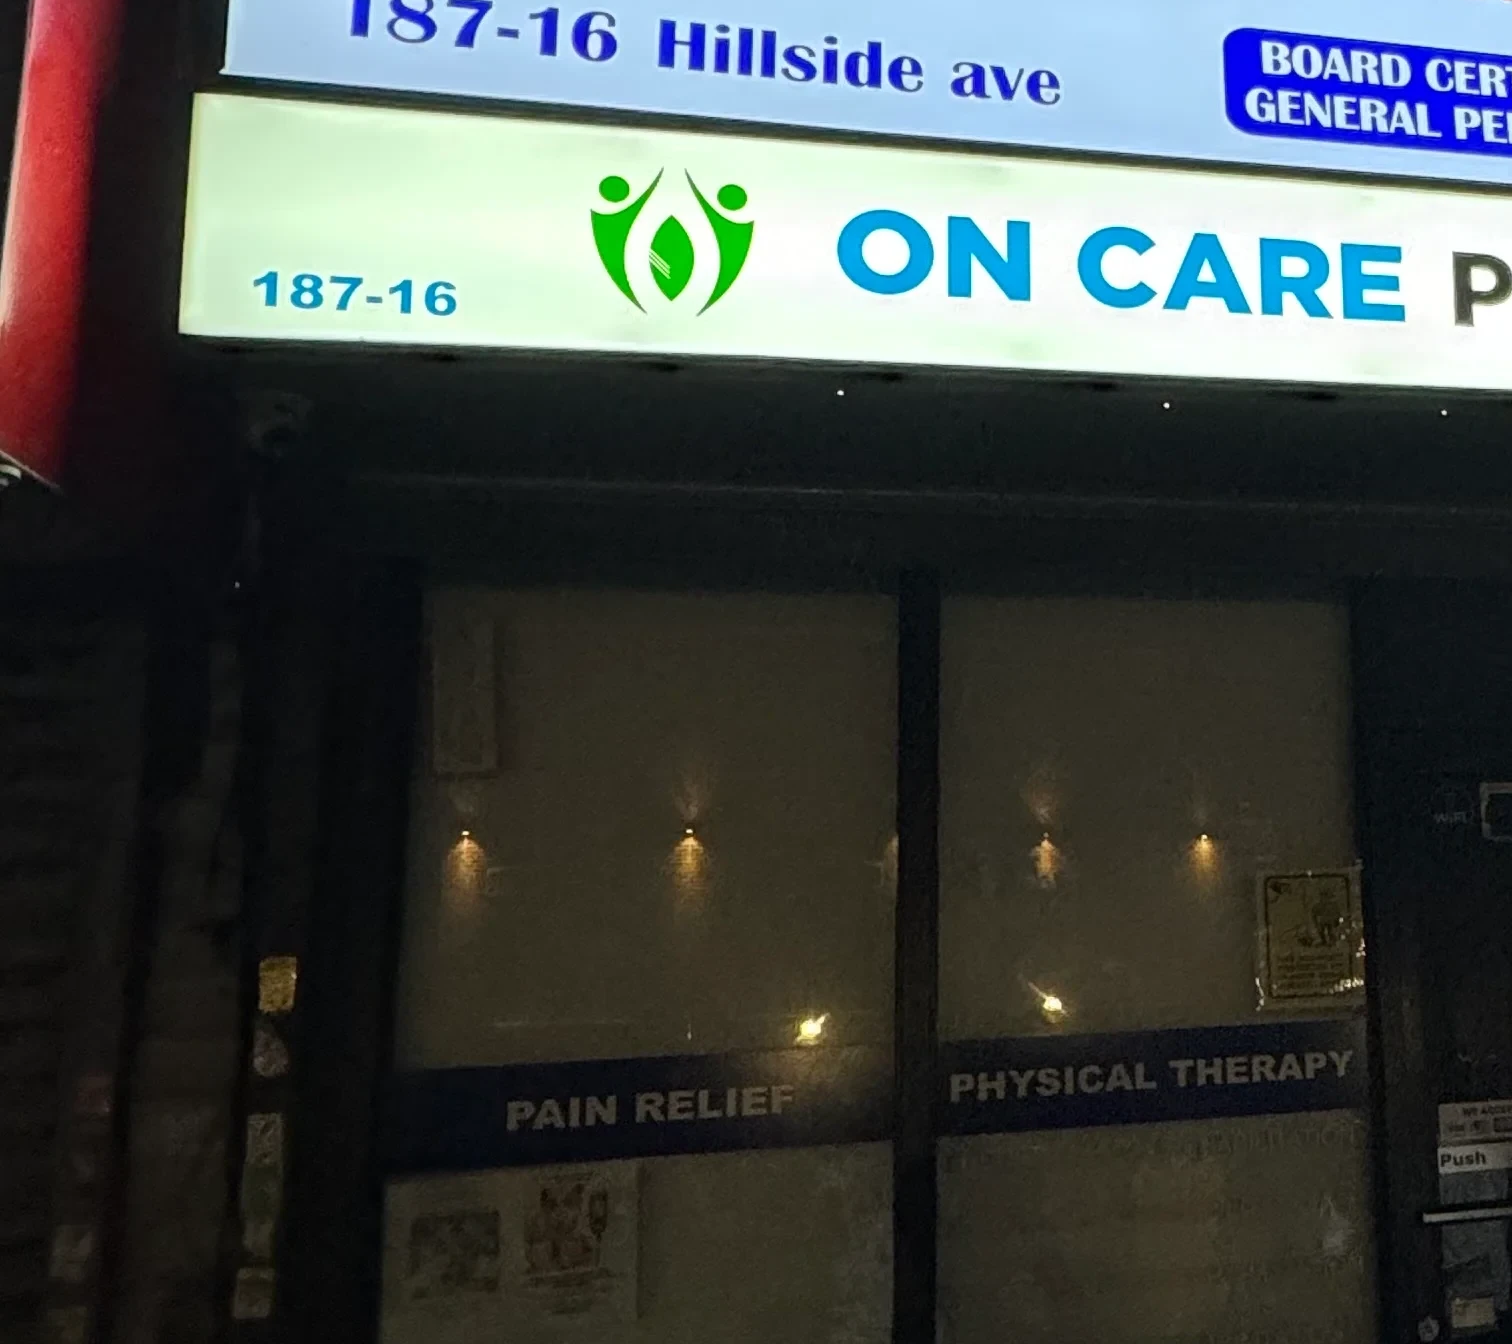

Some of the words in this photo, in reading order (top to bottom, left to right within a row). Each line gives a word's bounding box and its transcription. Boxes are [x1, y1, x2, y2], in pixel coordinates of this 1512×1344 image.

[658, 19, 923, 92] Hillside
[950, 62, 1060, 105] ave
[1261, 40, 1412, 87] BOARD
[1245, 87, 1442, 138] GENERAL
[836, 209, 1031, 302] ON
[1077, 226, 1406, 322] CARE
[253, 270, 457, 317] 187-16
[949, 1061, 1157, 1103] PHYSICAL
[1168, 1050, 1354, 1088] THERAPY
[505, 1096, 618, 1133] PAIN
[633, 1083, 797, 1124] RELIEF
[1440, 1150, 1487, 1168] Push
